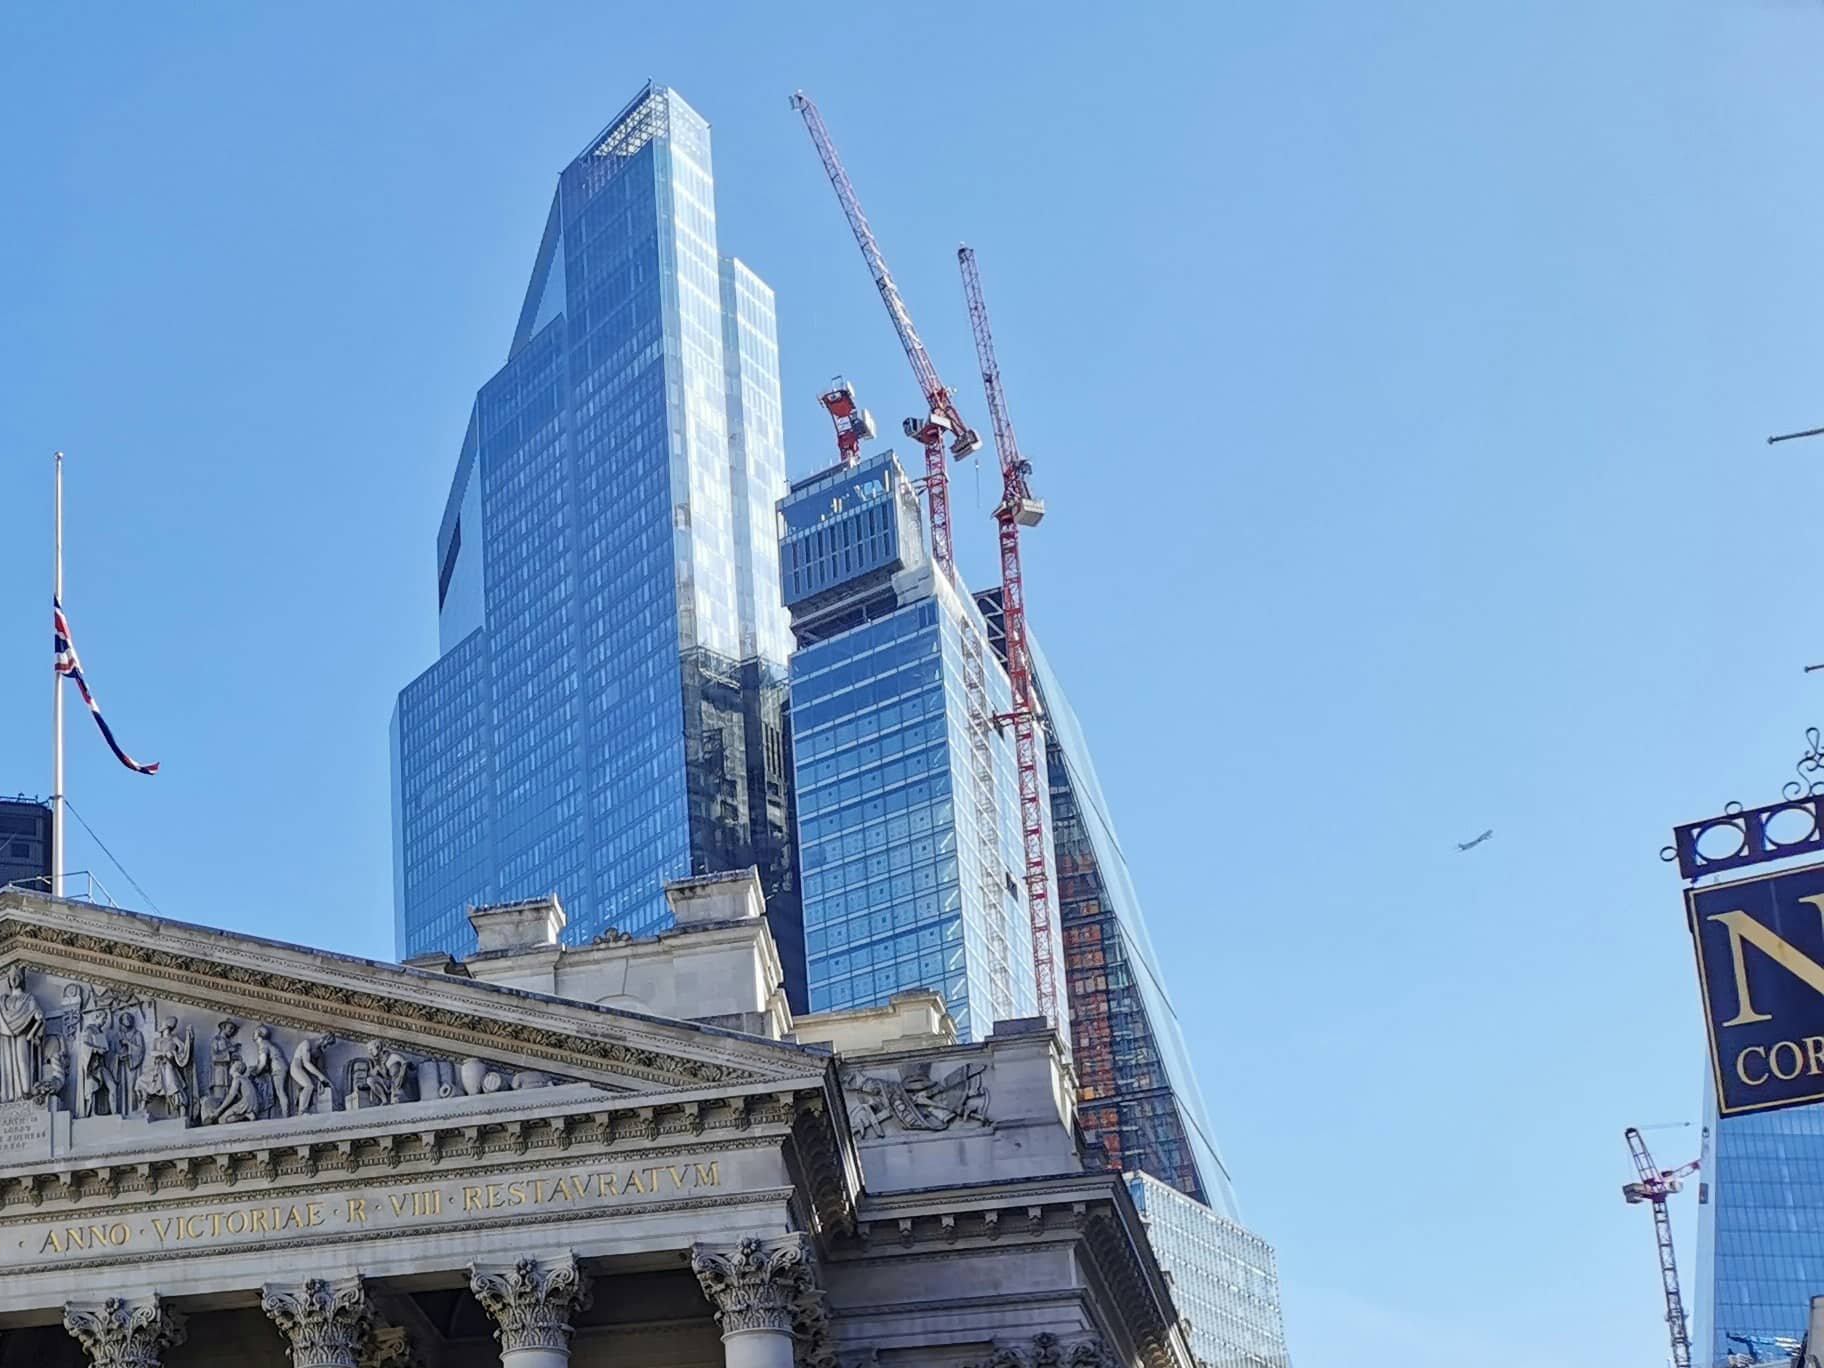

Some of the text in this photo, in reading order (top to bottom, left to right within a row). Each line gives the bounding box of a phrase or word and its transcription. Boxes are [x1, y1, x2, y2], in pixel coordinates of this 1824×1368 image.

[39, 1222, 132, 1254] ANNO
[151, 1201, 327, 1241] VICTORIAE
[345, 1198, 367, 1223] R
[388, 1189, 442, 1217] VIII
[462, 1160, 721, 1212] RESTAVRATVM
